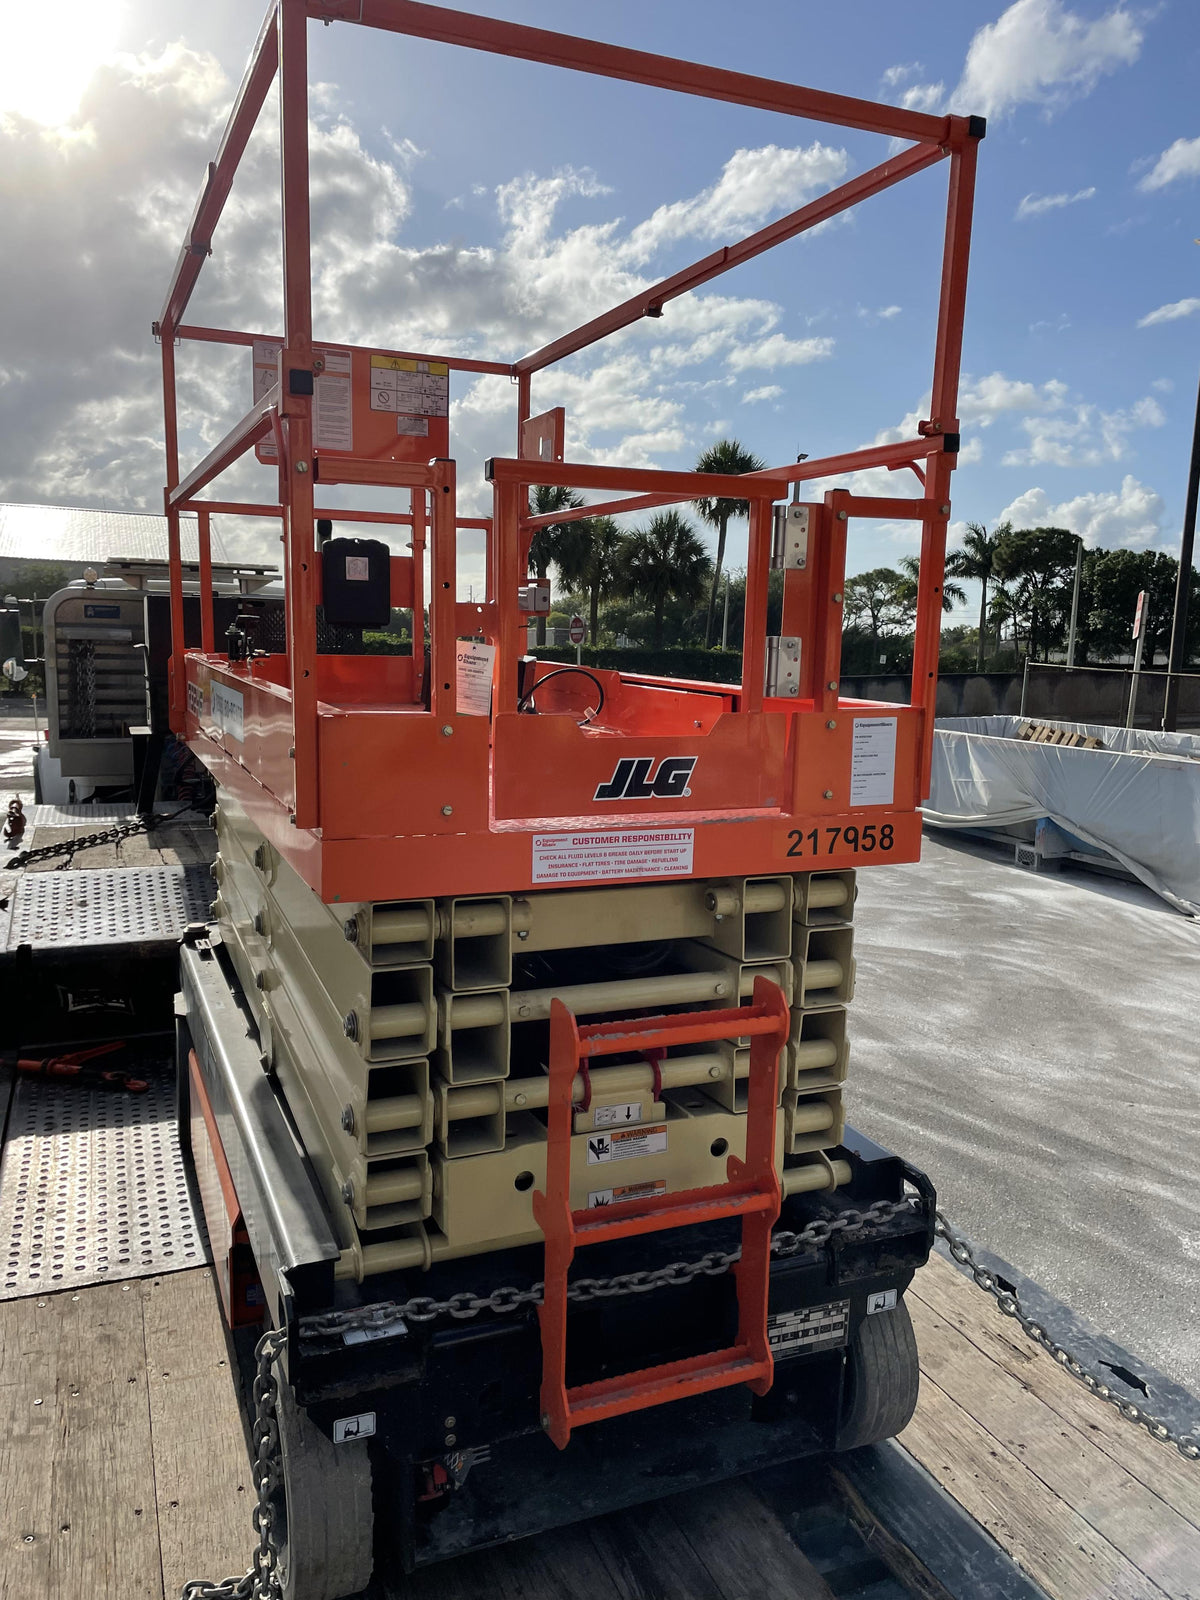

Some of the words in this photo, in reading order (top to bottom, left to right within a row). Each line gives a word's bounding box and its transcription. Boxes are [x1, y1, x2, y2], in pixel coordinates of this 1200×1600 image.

[592, 756, 698, 801] JLG
[572, 835, 620, 846] CUSTOMER
[622, 833, 693, 843] RESPONSIBILITY
[787, 823, 894, 857] 217958
[624, 866, 660, 874] MAINTENANCE
[626, 1127, 658, 1138] WARNING
